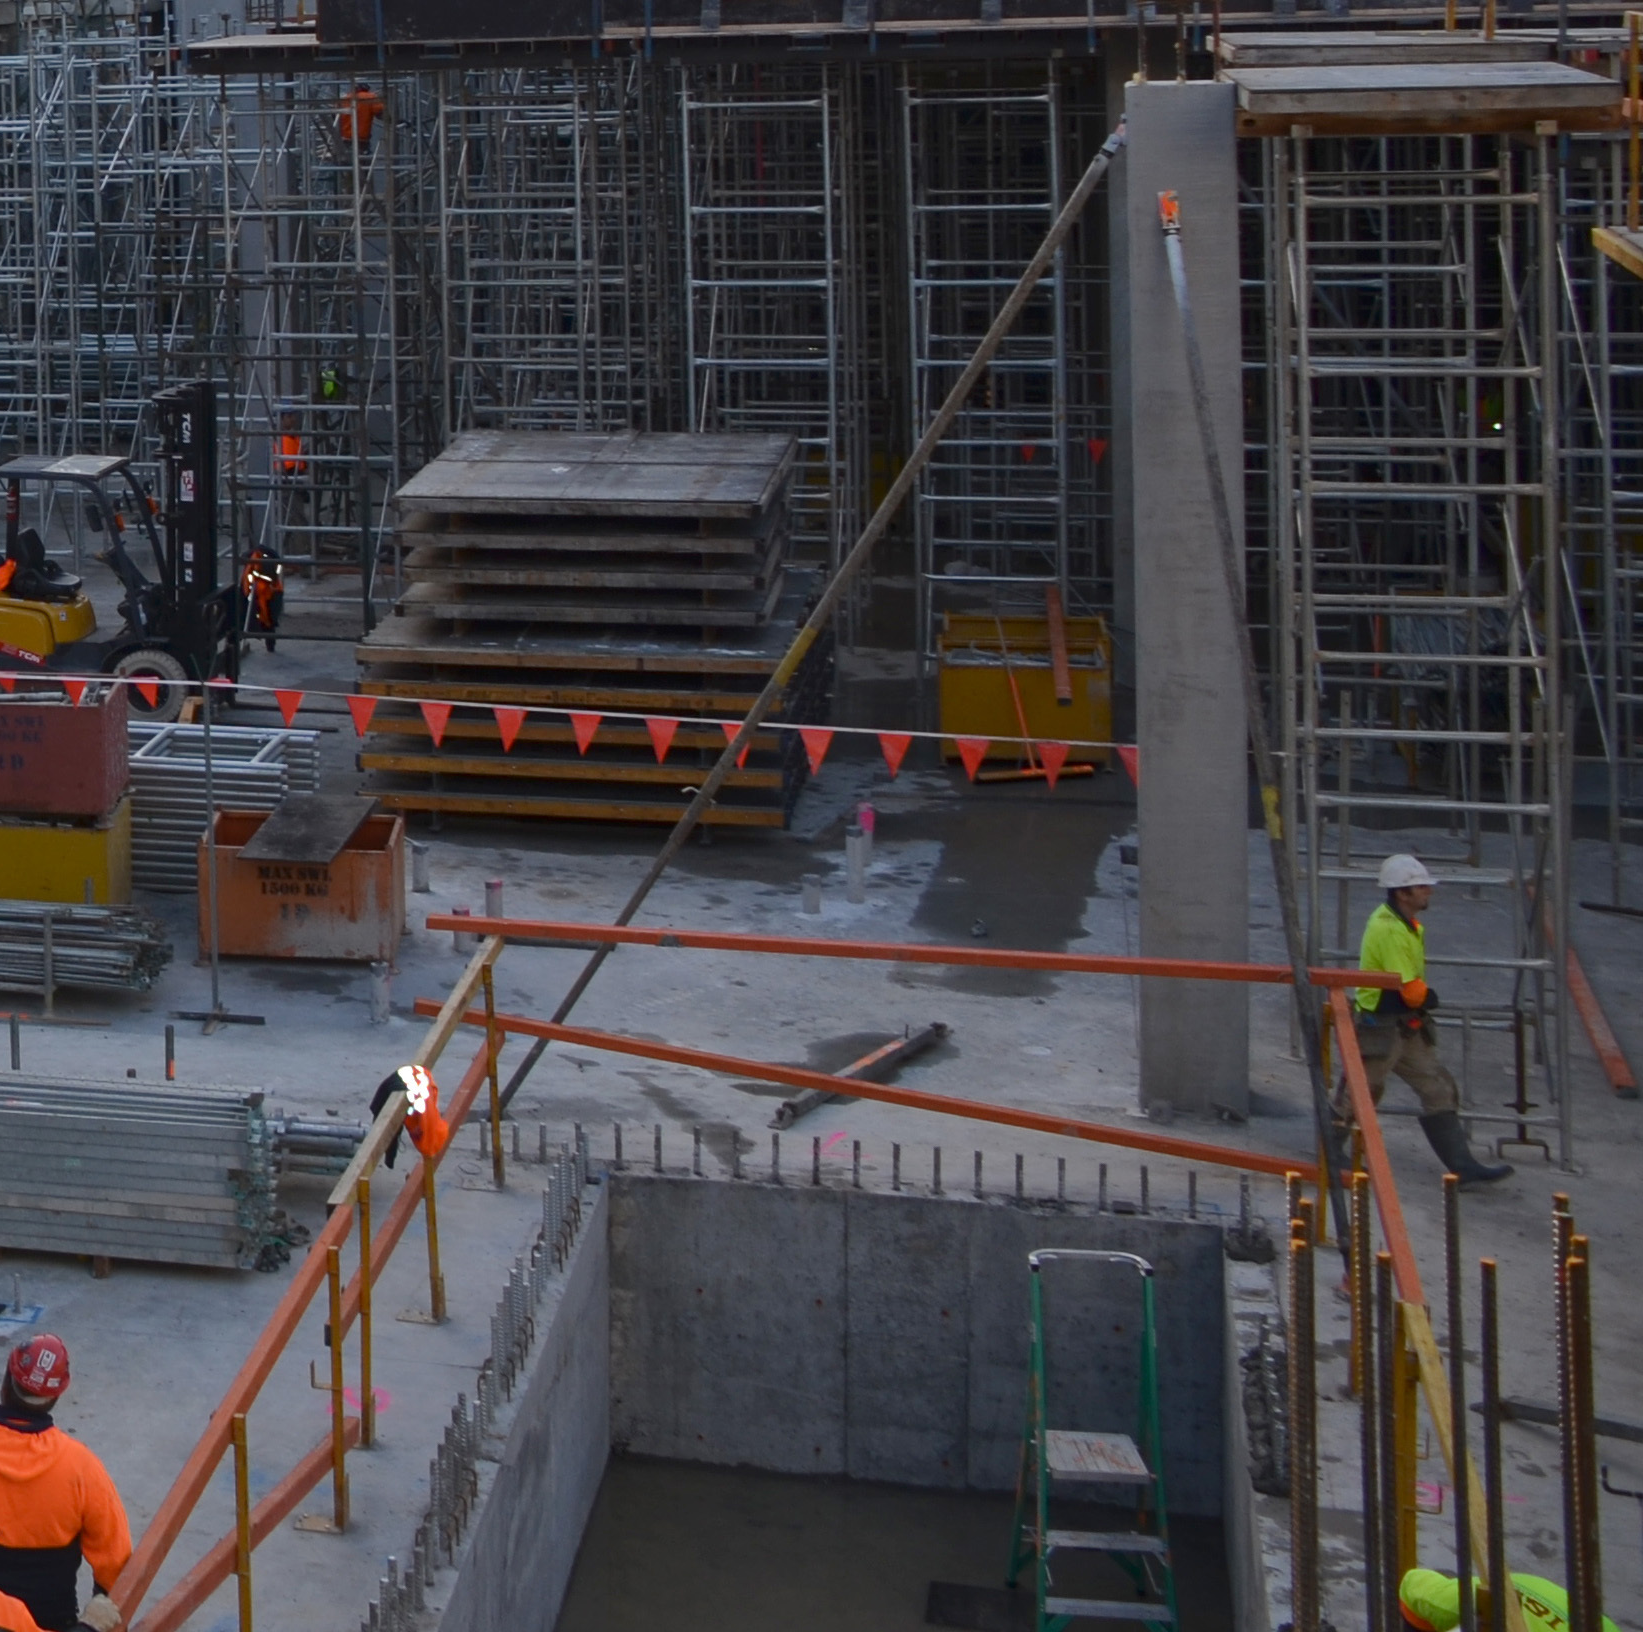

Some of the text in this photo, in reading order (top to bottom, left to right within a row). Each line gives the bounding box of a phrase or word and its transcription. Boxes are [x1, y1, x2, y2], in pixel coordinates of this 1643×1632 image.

[182, 413, 191, 443] TCM
[18, 650, 41, 664] TCM
[257, 866, 292, 879] MAX
[261, 882, 300, 896] 1500
